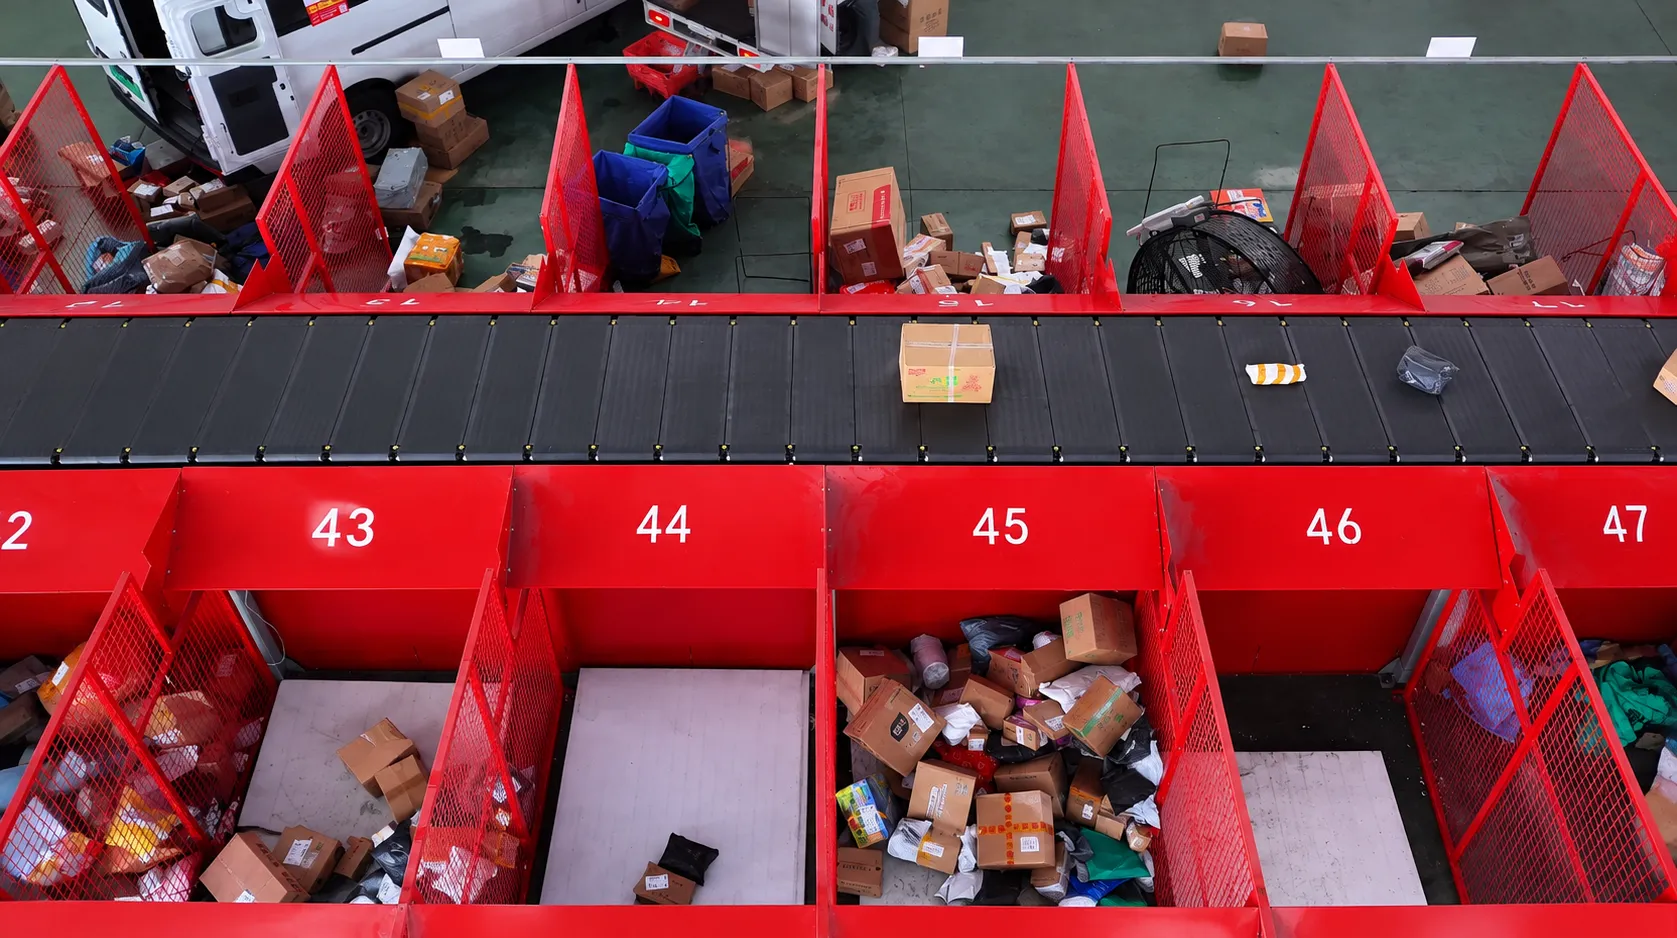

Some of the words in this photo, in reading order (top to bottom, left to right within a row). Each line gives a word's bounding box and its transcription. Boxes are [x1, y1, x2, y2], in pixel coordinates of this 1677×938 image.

[0, 510, 33, 550] 2
[311, 507, 375, 547] 43
[636, 504, 691, 543] 44
[972, 507, 1029, 545] 45
[1306, 507, 1362, 545] 46
[1602, 505, 1648, 543] 47
